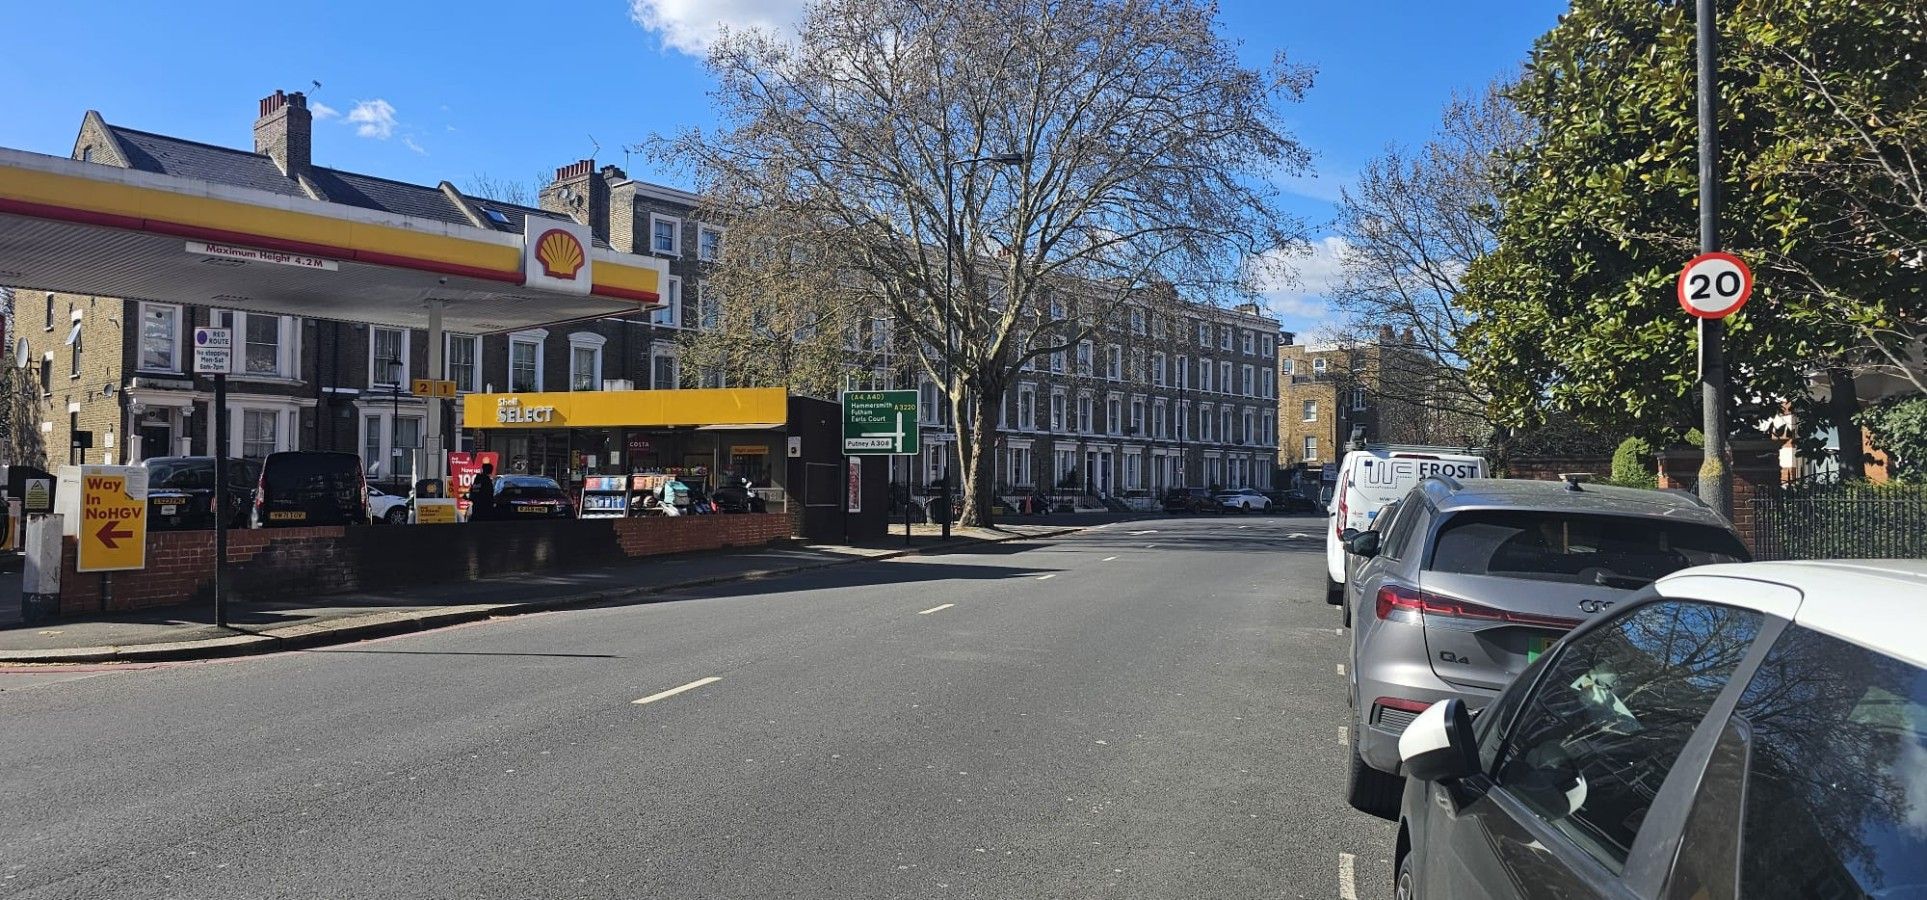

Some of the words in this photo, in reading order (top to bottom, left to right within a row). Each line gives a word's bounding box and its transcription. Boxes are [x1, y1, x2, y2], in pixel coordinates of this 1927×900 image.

[206, 244, 256, 258] Maximum
[259, 250, 290, 262] Height
[1689, 270, 1741, 300] 20
[419, 383, 429, 393] 2
[442, 384, 448, 394] 1
[497, 397, 518, 406] Shell
[496, 405, 554, 423] SELECT
[1419, 462, 1478, 479] FROST
[87, 478, 122, 492] Way
[86, 493, 101, 505] In
[85, 507, 142, 520] NoHGV
[1439, 651, 1471, 665] Q4
